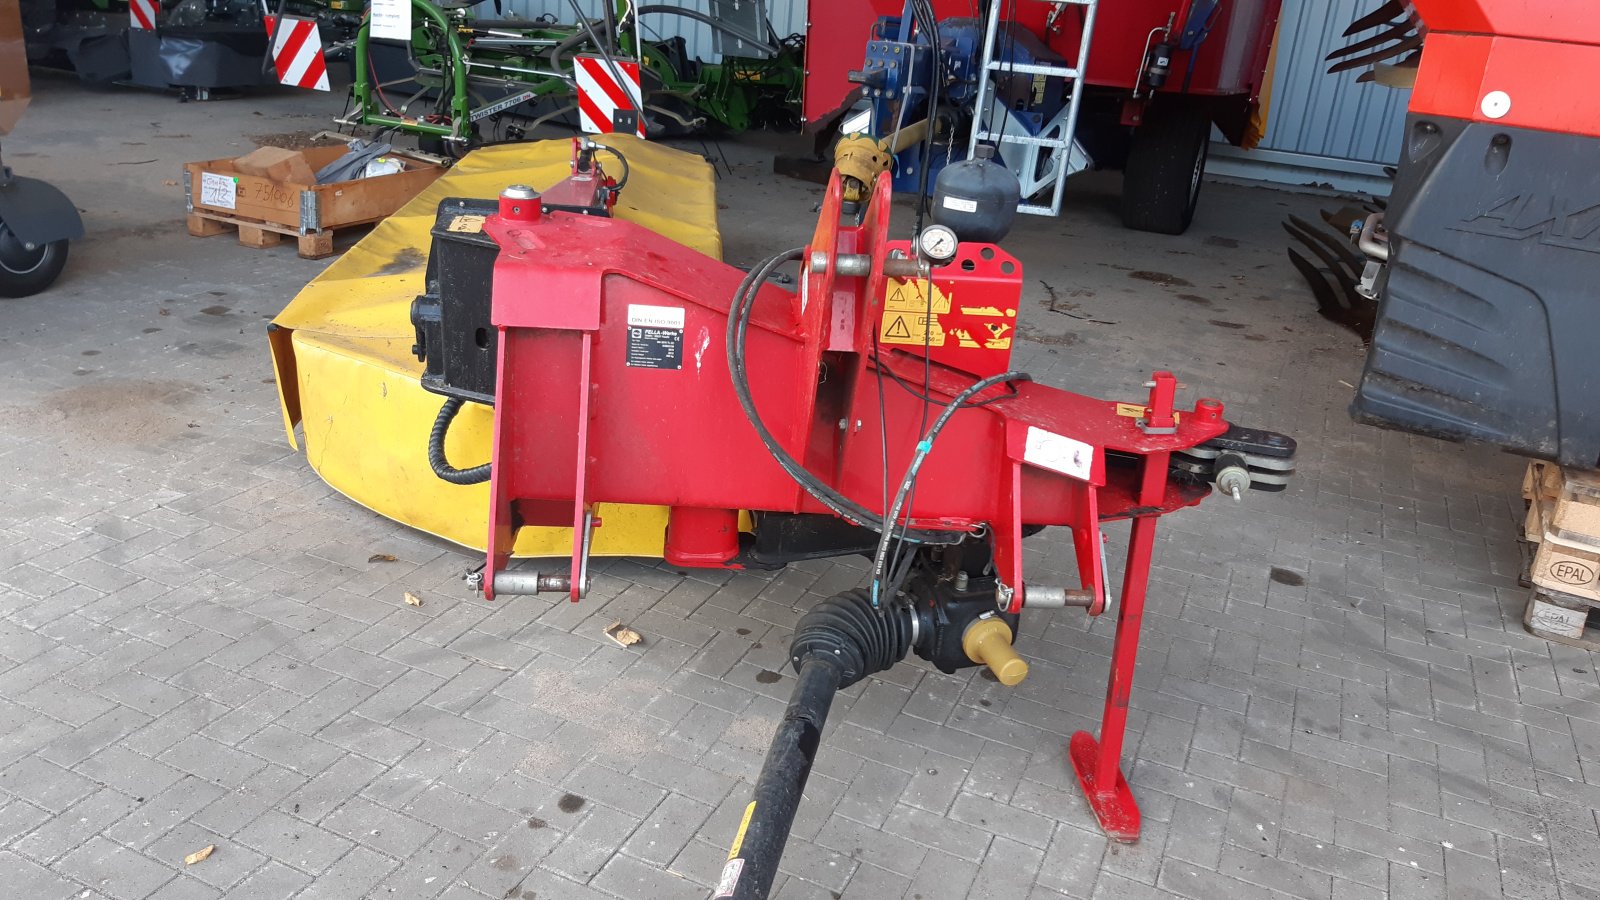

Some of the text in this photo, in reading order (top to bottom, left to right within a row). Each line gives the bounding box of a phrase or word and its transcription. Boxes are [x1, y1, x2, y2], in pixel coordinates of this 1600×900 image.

[470, 105, 503, 120] TWISTER
[504, 96, 521, 109] 7706
[1556, 564, 1586, 582] EPAL
